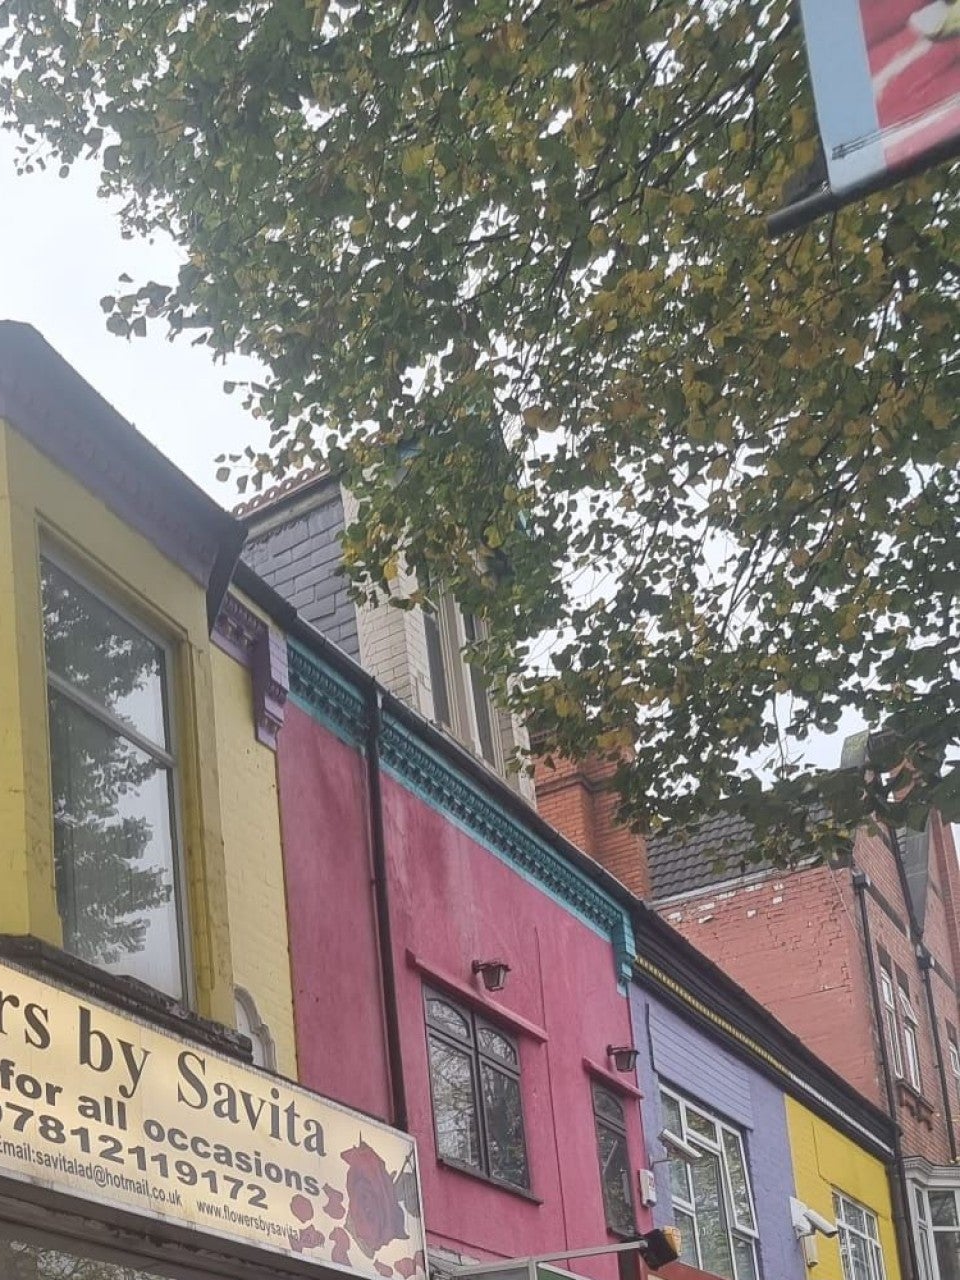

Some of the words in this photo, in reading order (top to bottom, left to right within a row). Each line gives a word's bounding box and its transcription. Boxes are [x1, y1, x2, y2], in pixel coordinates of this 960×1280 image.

[78, 1005, 151, 1099] by
[176, 1050, 328, 1158] Savita
[77, 1095, 128, 1131] all
[142, 1118, 320, 1197] occasions
